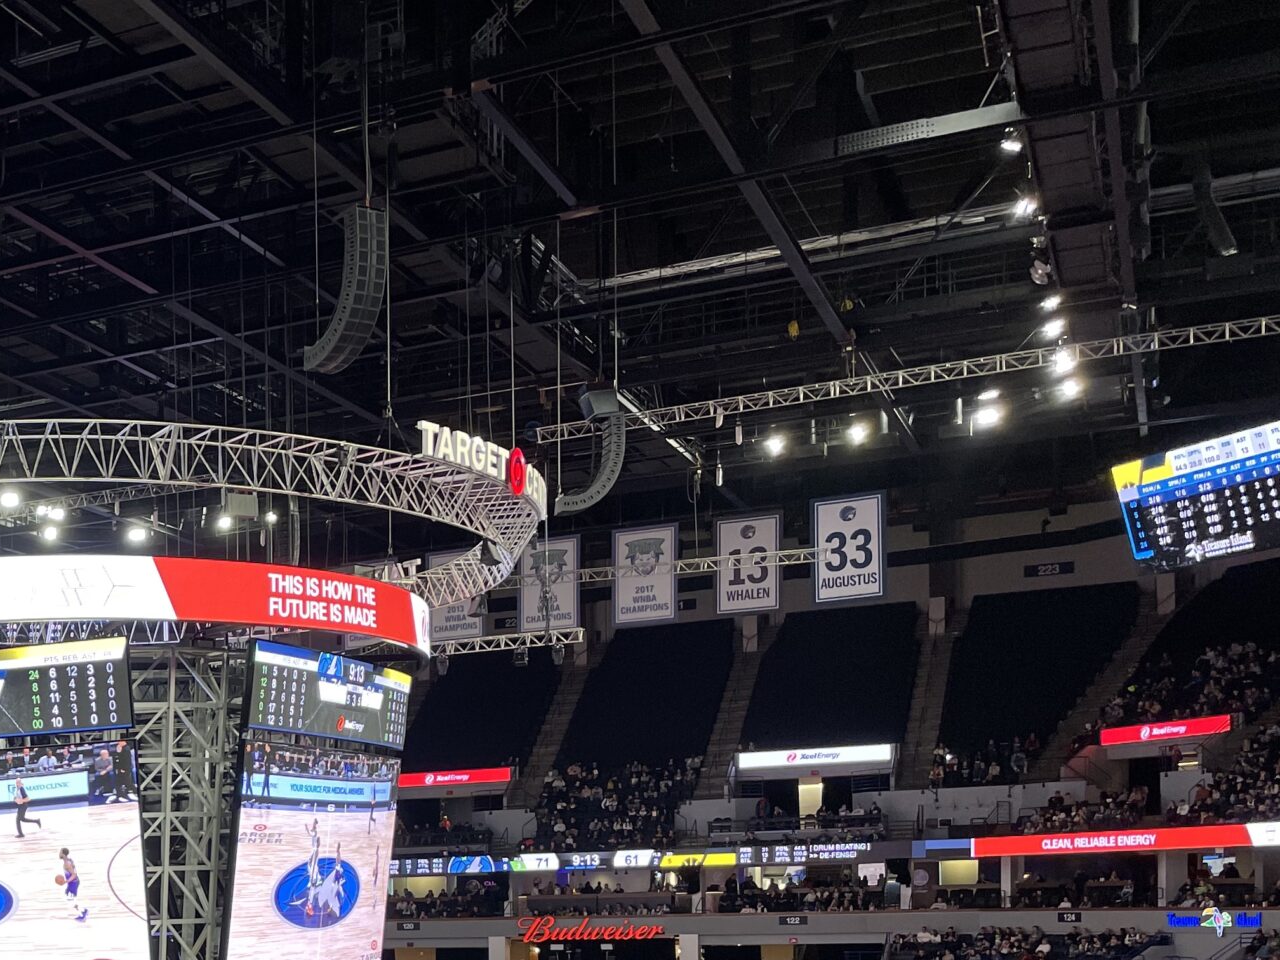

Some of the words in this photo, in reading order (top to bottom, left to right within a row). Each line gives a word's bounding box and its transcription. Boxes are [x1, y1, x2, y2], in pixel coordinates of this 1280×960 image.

[416, 419, 511, 482] TARGET
[824, 528, 873, 572] 33
[727, 546, 769, 586] 13
[1037, 564, 1060, 576] 223
[820, 572, 877, 590] AUGUSTUS
[268, 572, 304, 595] THIS
[306, 577, 320, 597] IS
[322, 579, 353, 601] HOW
[355, 584, 376, 606] THE
[634, 584, 655, 594] 2017
[726, 587, 770, 602] WHALEN
[632, 593, 657, 604] WNBA
[269, 597, 328, 622] FUTURE
[330, 604, 342, 623] IS
[344, 605, 377, 628] MADE
[447, 605, 465, 614] 2013
[620, 602, 670, 615] CHAMPIONS
[444, 613, 467, 623] WNBA
[433, 622, 478, 633] CHAMPIONS
[28, 670, 40, 680] 24
[49, 667, 57, 678] 6
[66, 666, 78, 677] 12
[87, 664, 95, 675] 3
[106, 662, 113, 673] 0
[349, 663, 365, 683] 9:13
[50, 680, 58, 691] 6
[69, 679, 76, 689] 4
[88, 677, 96, 687] 2
[107, 675, 114, 686] 4
[31, 695, 41, 704] 11
[50, 692, 60, 703] 11
[70, 691, 77, 701] 5
[89, 689, 96, 700] 3
[108, 687, 115, 698] 0
[52, 704, 59, 715] 4
[71, 704, 78, 714] 3
[109, 700, 116, 710] 0
[32, 719, 43, 729] 00
[51, 717, 63, 727] 10
[90, 714, 98, 724] 0
[110, 712, 117, 723] 0
[817, 751, 840, 760] Energy
[814, 844, 835, 852] DRUM
[835, 843, 866, 851] BEATING
[1042, 837, 1073, 850] CLEAN,
[1074, 836, 1116, 848] RELIABLE
[1117, 834, 1156, 847] ENERGY
[536, 857, 549, 868] 71
[572, 854, 600, 867] 9:13
[624, 855, 638, 865] 61
[1062, 913, 1076, 921] 124
[517, 915, 666, 943] Budweiser
